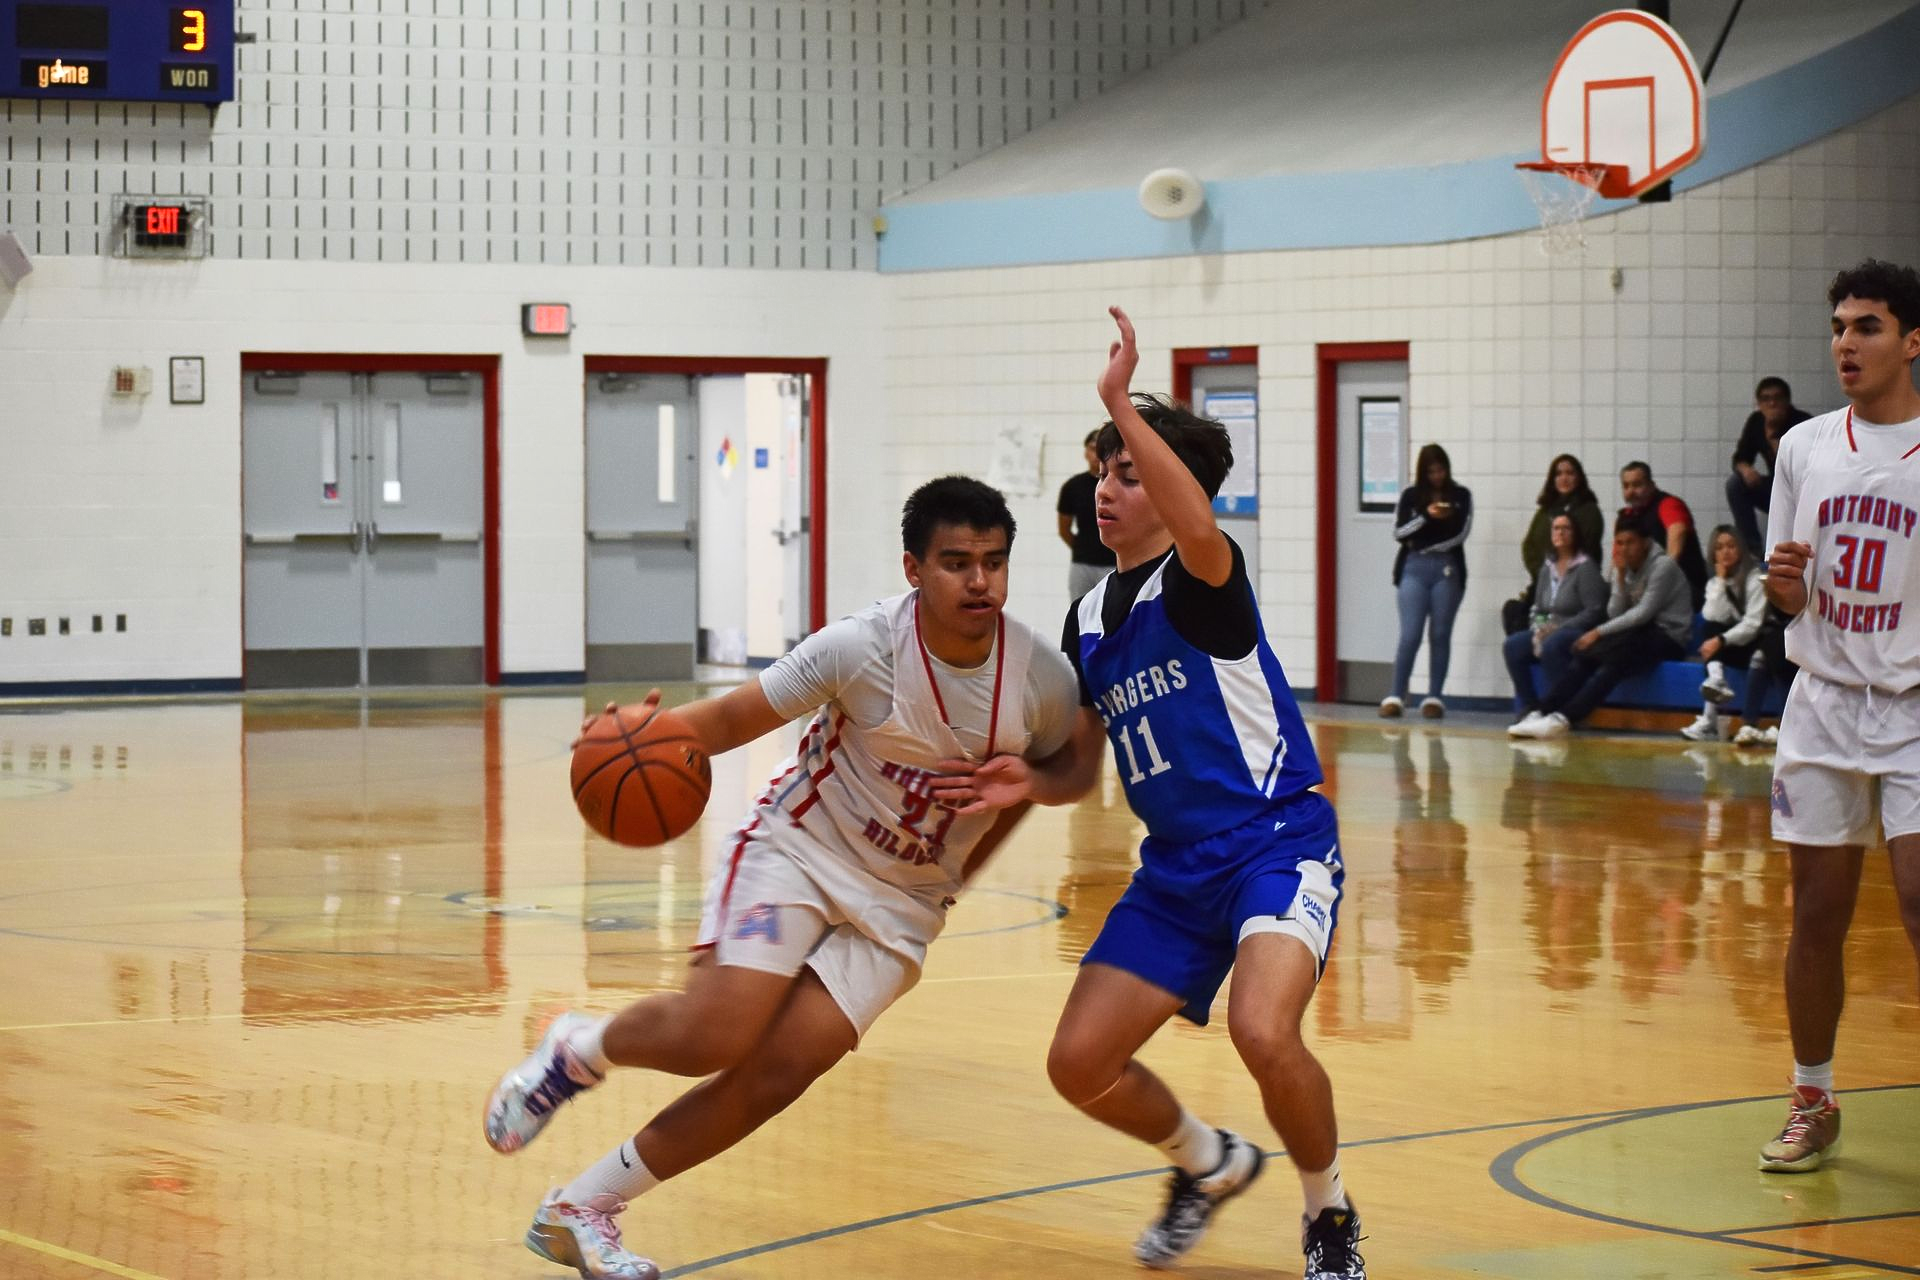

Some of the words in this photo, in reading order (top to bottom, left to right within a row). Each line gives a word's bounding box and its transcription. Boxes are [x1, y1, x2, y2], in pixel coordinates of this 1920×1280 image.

[182, 9, 205, 52] 3
[38, 64, 89, 88] game
[170, 68, 209, 88] won
[147, 207, 180, 235] EXIT
[1818, 494, 1918, 539] ANTHONY
[1833, 534, 1888, 594] 30
[1818, 589, 1903, 634] WIDCATS
[1094, 659, 1188, 729] CRGERS
[1118, 715, 1172, 785] 11
